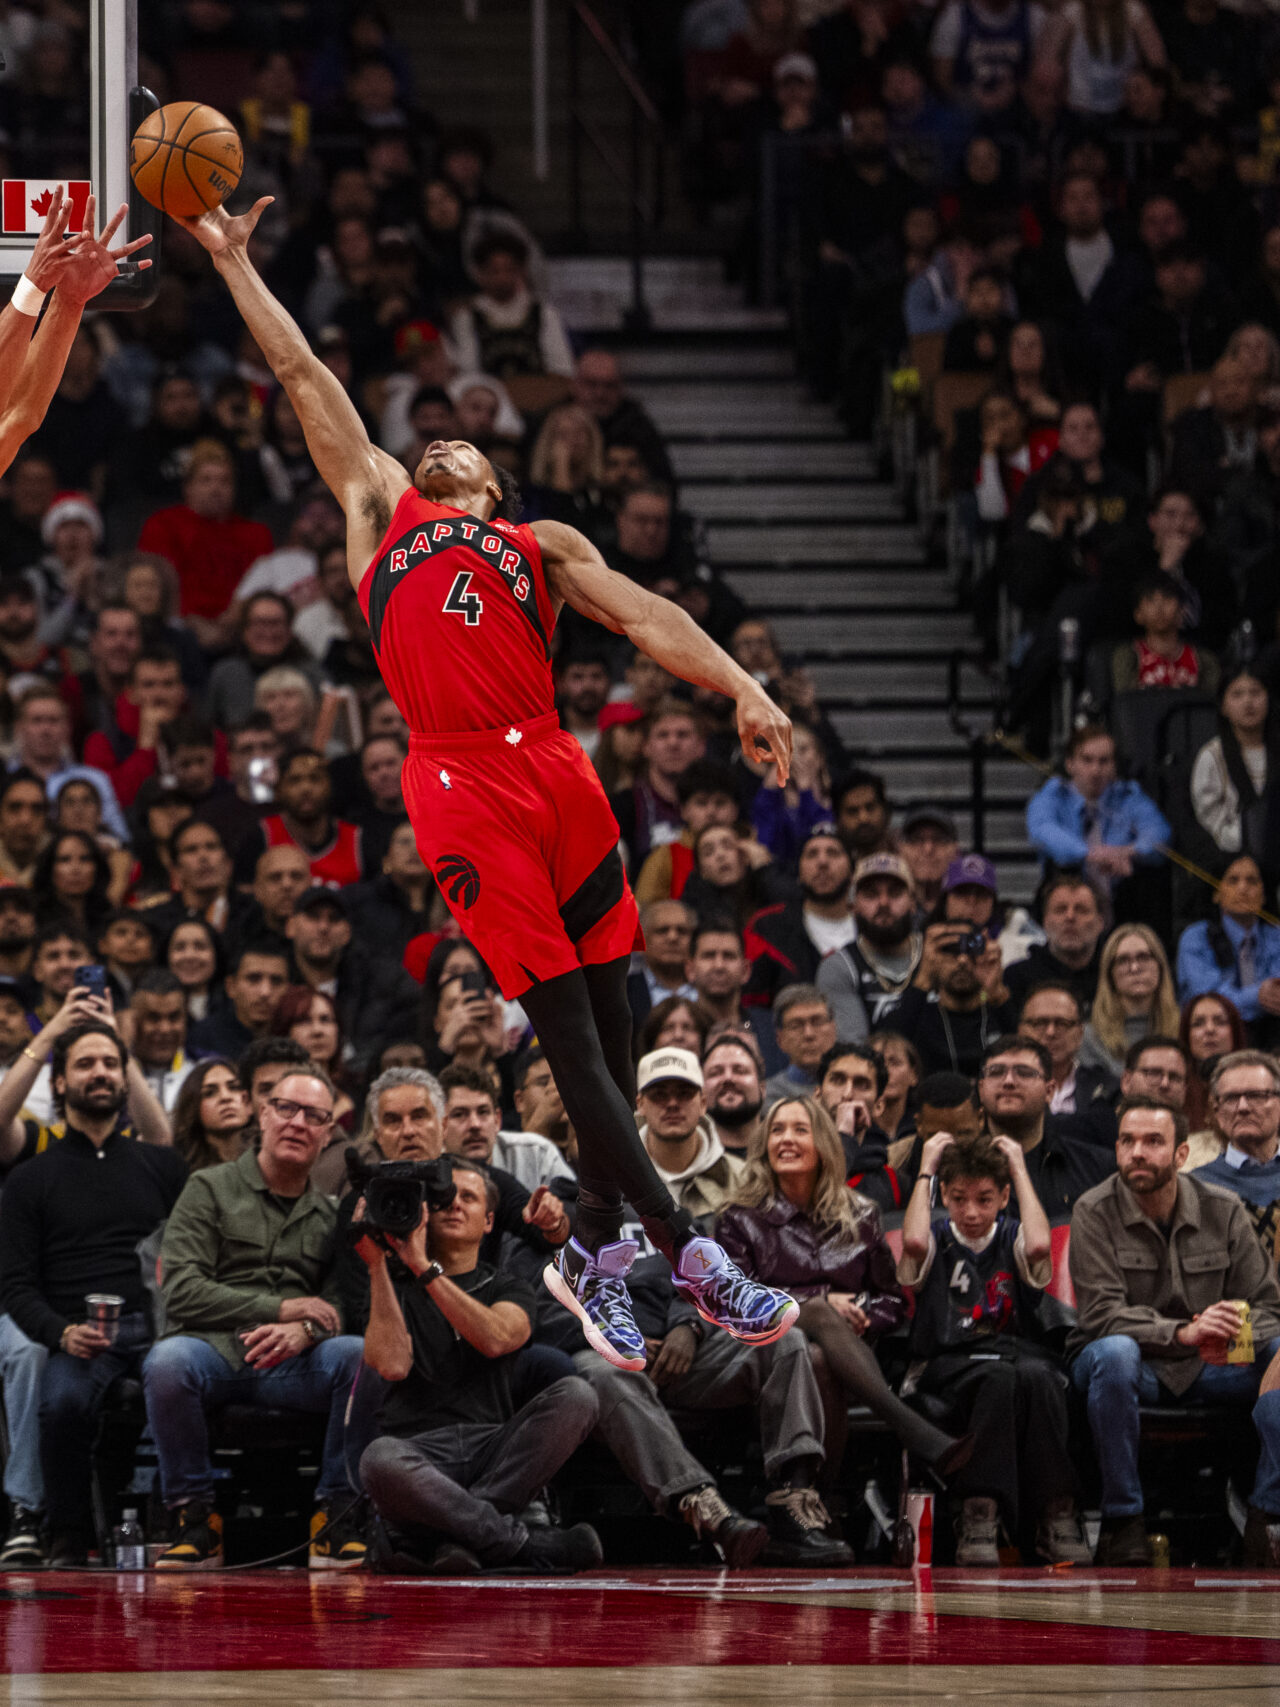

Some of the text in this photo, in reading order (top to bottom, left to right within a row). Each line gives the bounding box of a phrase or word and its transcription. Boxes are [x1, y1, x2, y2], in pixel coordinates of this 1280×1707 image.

[390, 523, 530, 601] RAPTORS
[442, 571, 483, 626] 4
[949, 1260, 970, 1293] 4
